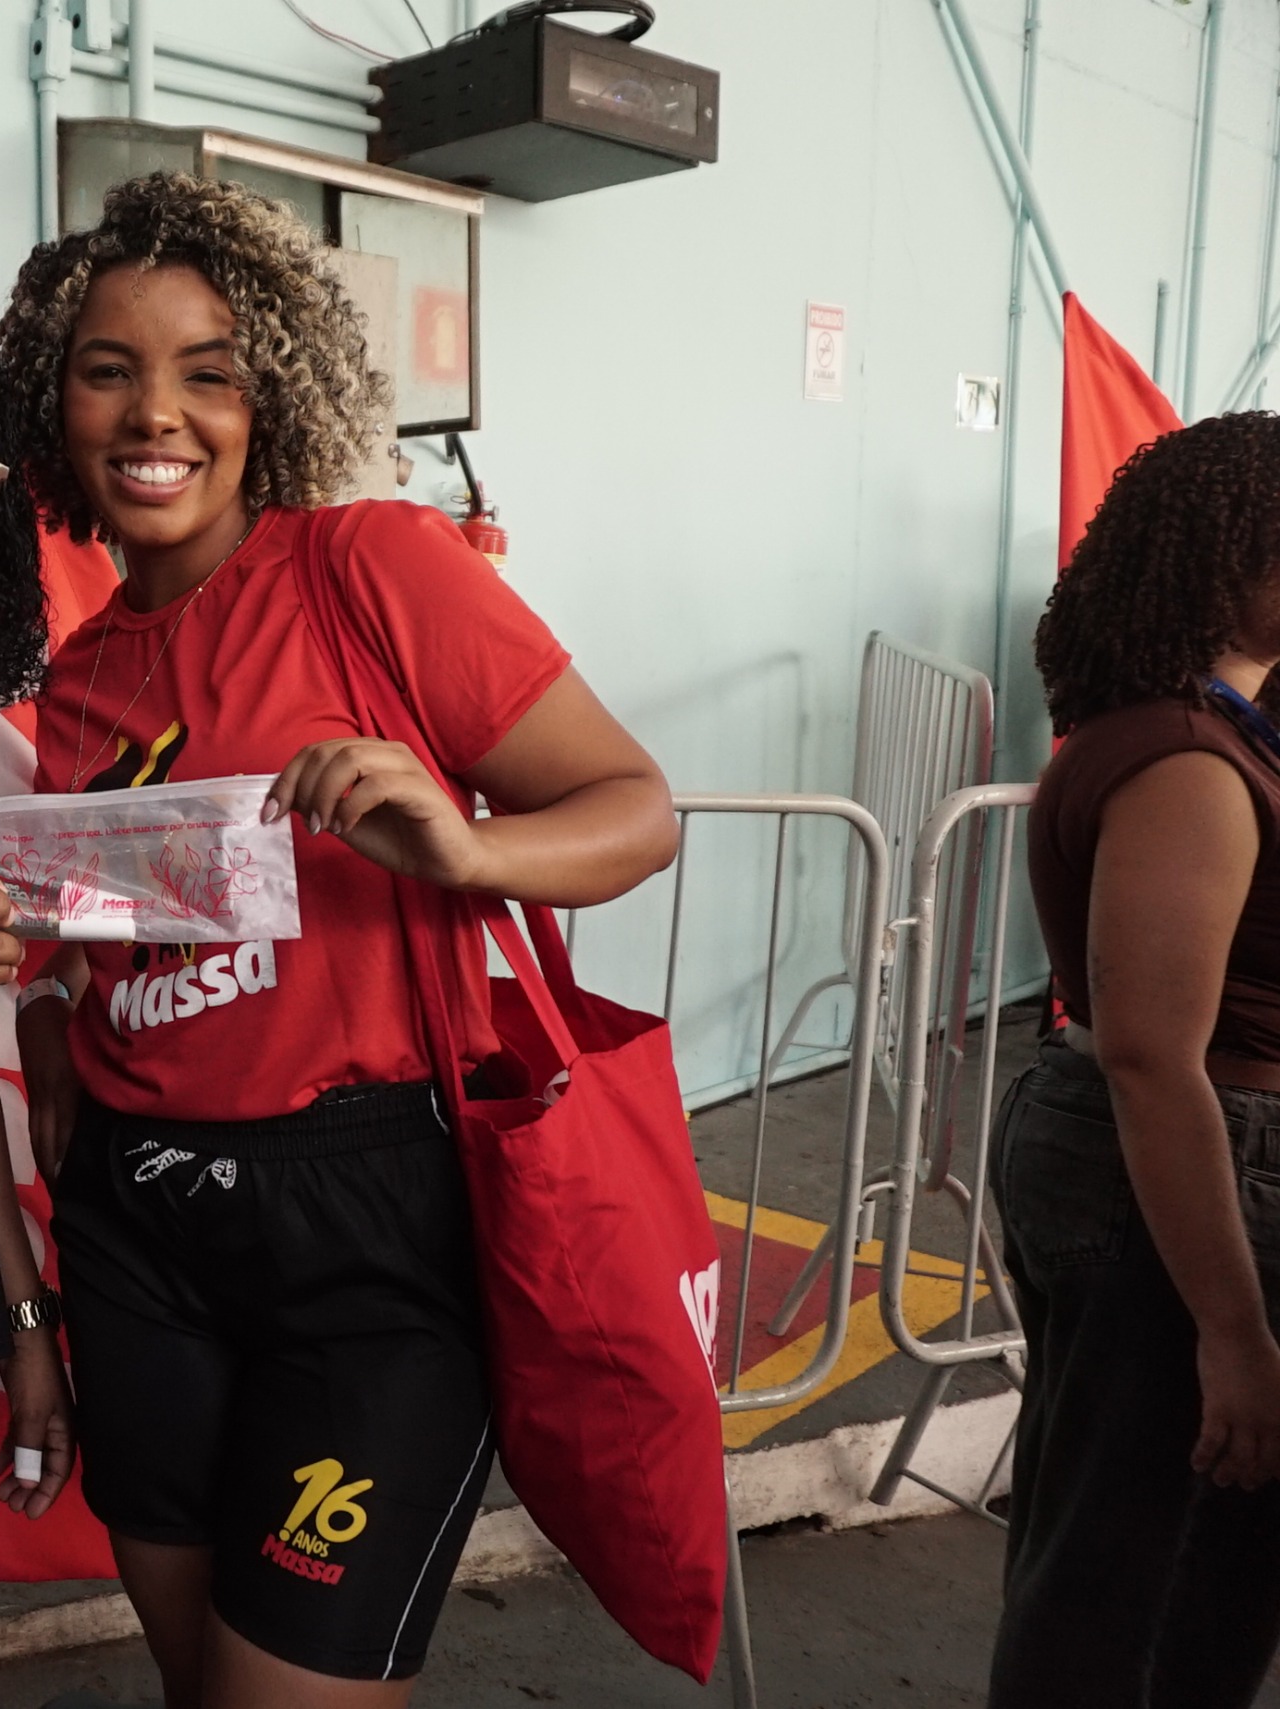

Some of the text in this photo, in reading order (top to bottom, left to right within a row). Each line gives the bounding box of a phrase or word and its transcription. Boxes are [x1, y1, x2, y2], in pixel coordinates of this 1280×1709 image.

[170, 822, 185, 832] por
[109, 939, 278, 1037] Massa
[279, 1457, 374, 1543] 16
[261, 1532, 346, 1586] Massa
[292, 1529, 330, 1558] ANOS
